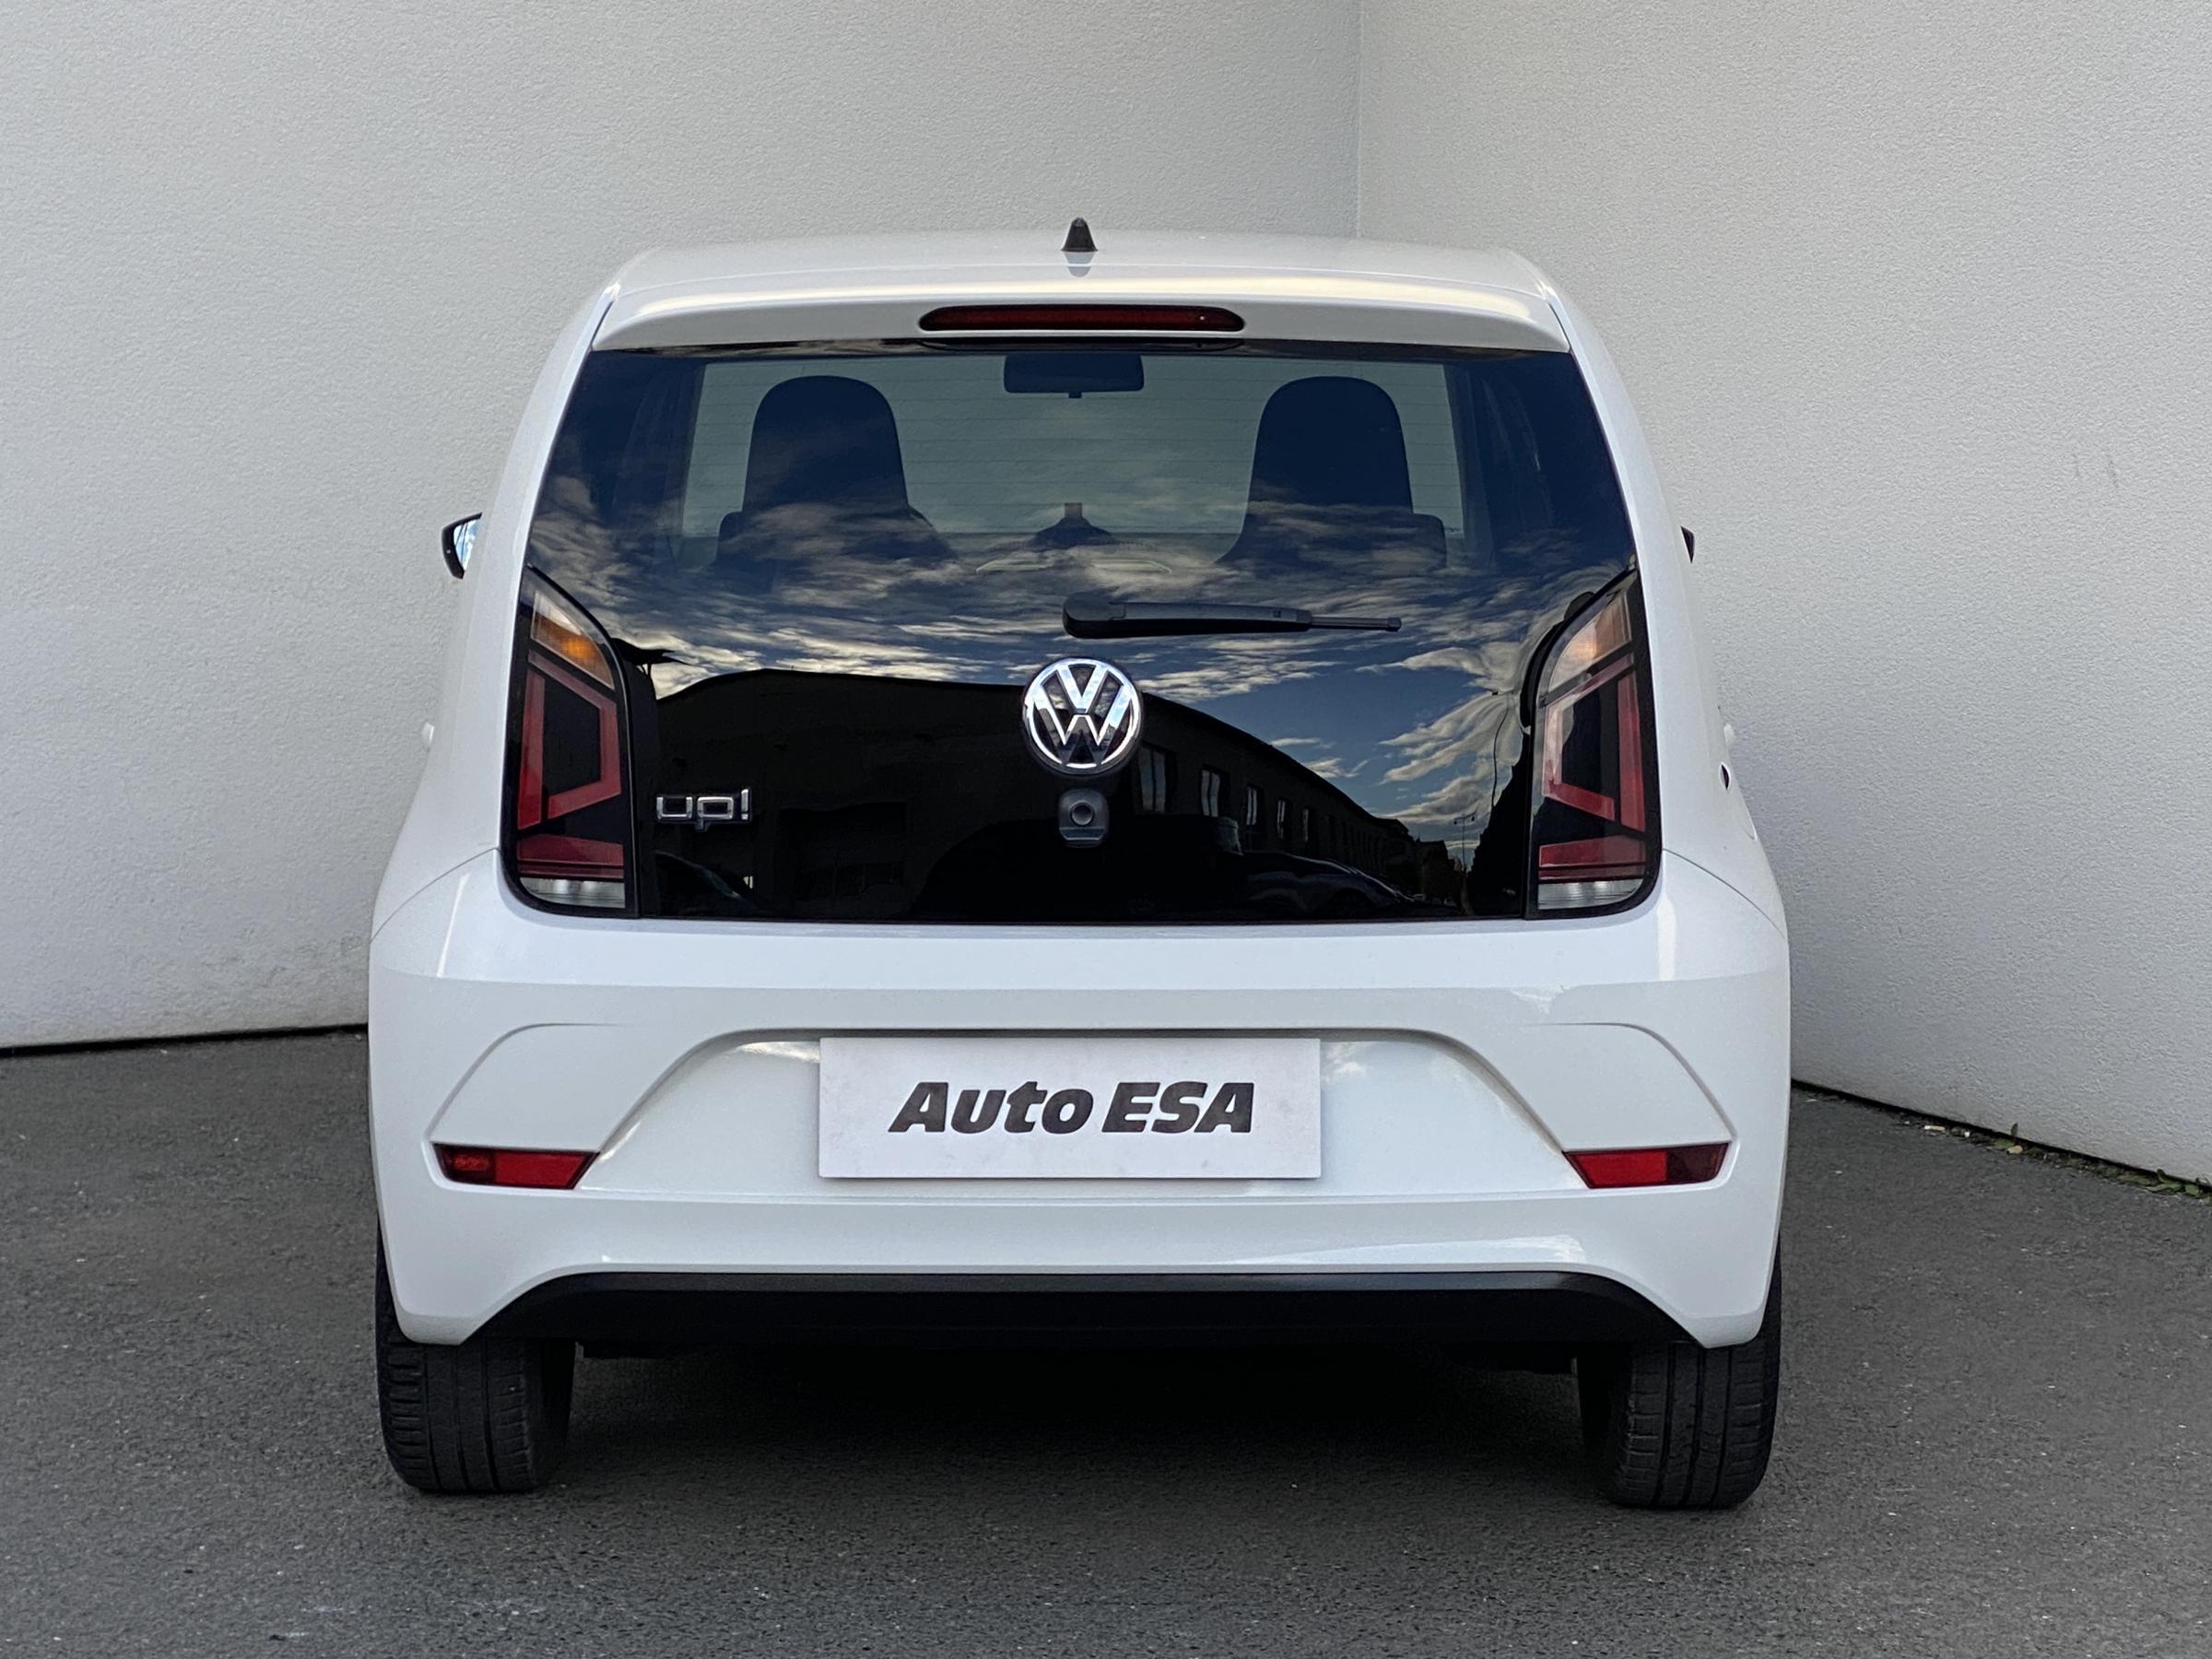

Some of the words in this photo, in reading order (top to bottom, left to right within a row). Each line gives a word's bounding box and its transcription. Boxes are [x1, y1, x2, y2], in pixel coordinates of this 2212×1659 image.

[1026, 660, 1139, 772] VW
[656, 789, 749, 830] up!
[888, 1081, 1094, 1135] Auto
[1101, 1081, 1254, 1134] ESA
